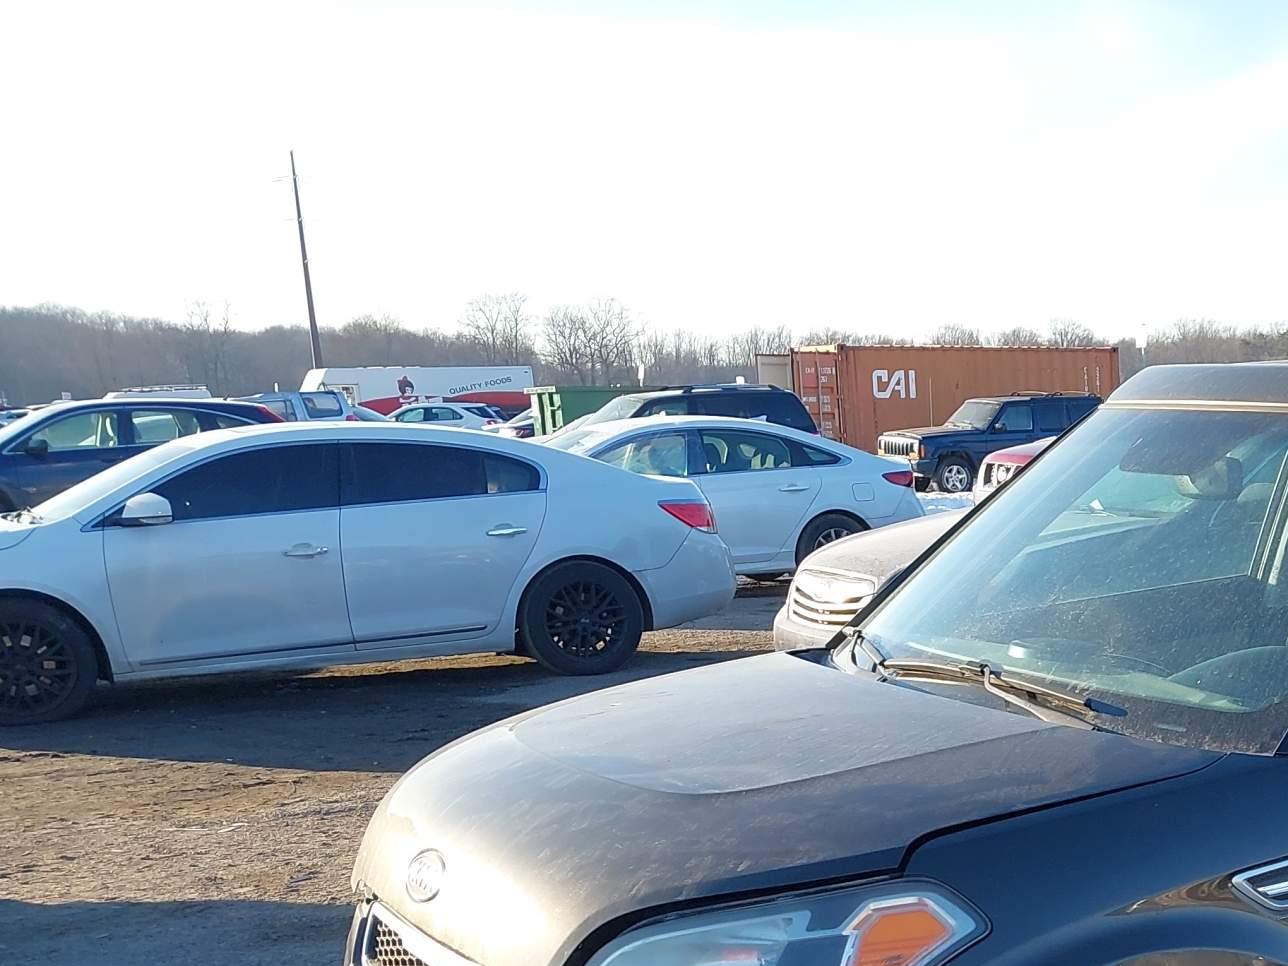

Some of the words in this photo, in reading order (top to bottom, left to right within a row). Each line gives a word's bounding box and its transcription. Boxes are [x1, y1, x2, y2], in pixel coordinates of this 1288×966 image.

[449, 382, 482, 395] QUALITY
[484, 376, 512, 388] FOODS
[872, 369, 917, 399] CAI
